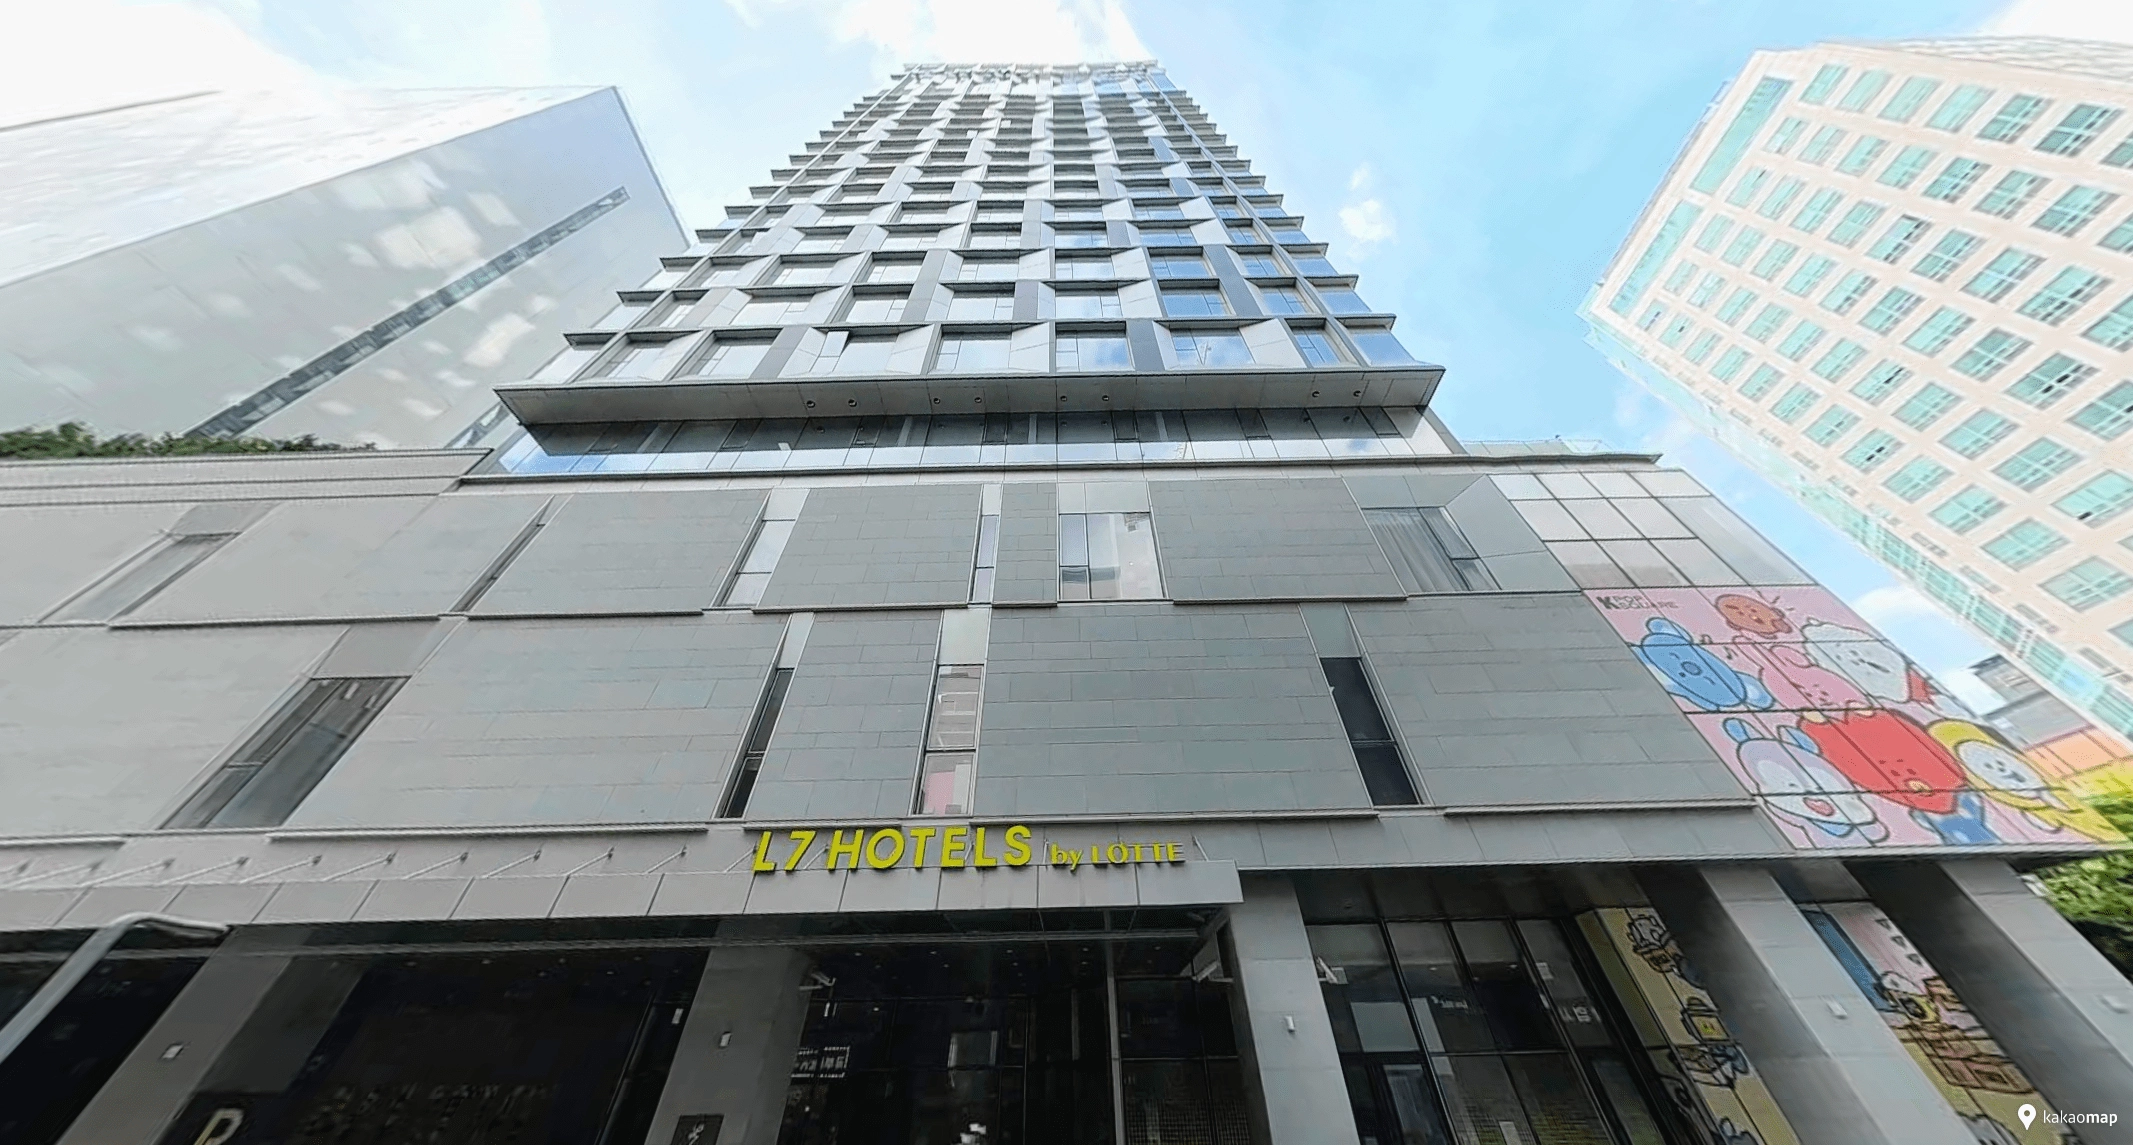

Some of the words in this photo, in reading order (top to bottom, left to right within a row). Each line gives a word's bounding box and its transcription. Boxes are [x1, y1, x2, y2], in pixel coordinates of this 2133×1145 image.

[753, 829, 817, 873] L7
[827, 825, 1032, 870] HOTELS
[1051, 842, 1082, 872] by
[1090, 842, 1185, 865] LOTTE
